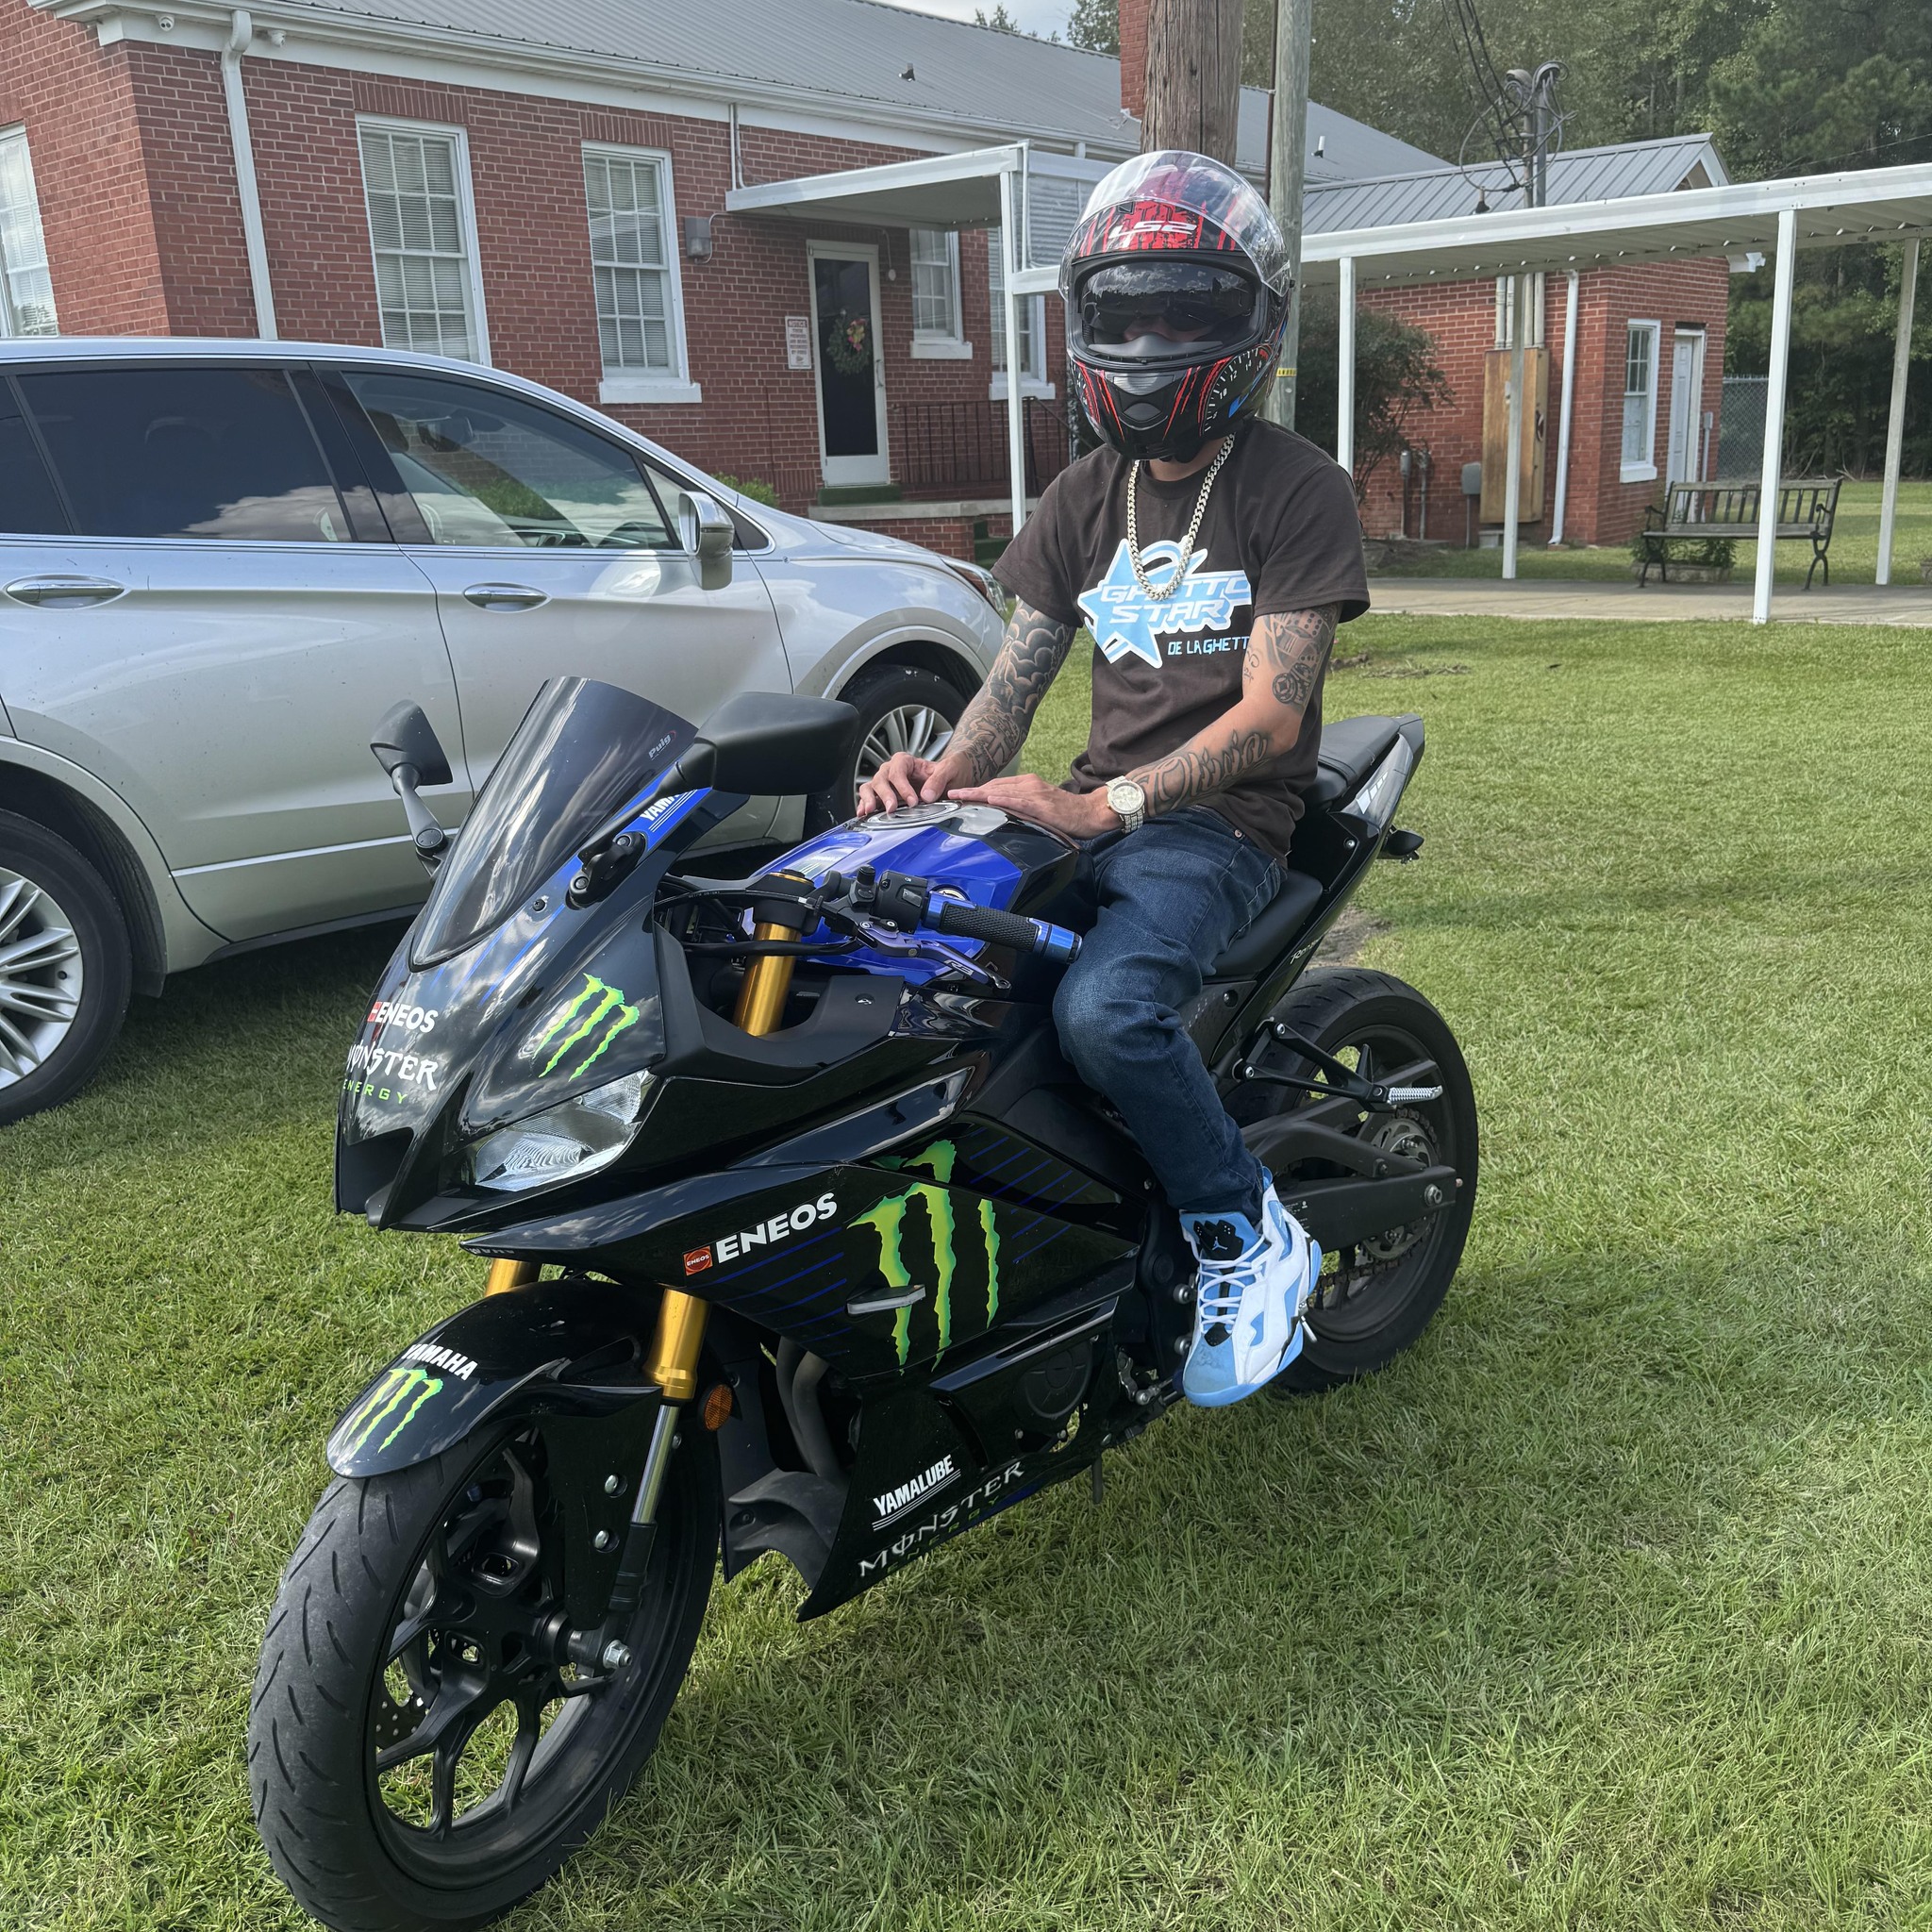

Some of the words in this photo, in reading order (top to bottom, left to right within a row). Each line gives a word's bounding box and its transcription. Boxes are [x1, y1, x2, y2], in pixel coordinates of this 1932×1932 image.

[1108, 220, 1197, 248] LS2
[1100, 576, 1250, 604] GHTTO
[1109, 598, 1224, 624] STAR
[1167, 641, 1183, 656] DE
[648, 734, 671, 759] Puig
[639, 794, 680, 822] YAM
[375, 1001, 439, 1033] ENEOS
[346, 1039, 438, 1091] MONSTER
[342, 1078, 408, 1105] ENERGY
[715, 1191, 838, 1264] ENEOS
[686, 1254, 709, 1266] ENEOS
[401, 1343, 478, 1381] YAMAHA
[873, 1454, 955, 1517] YAMALUBE
[858, 1461, 1024, 1577] MONSTER
